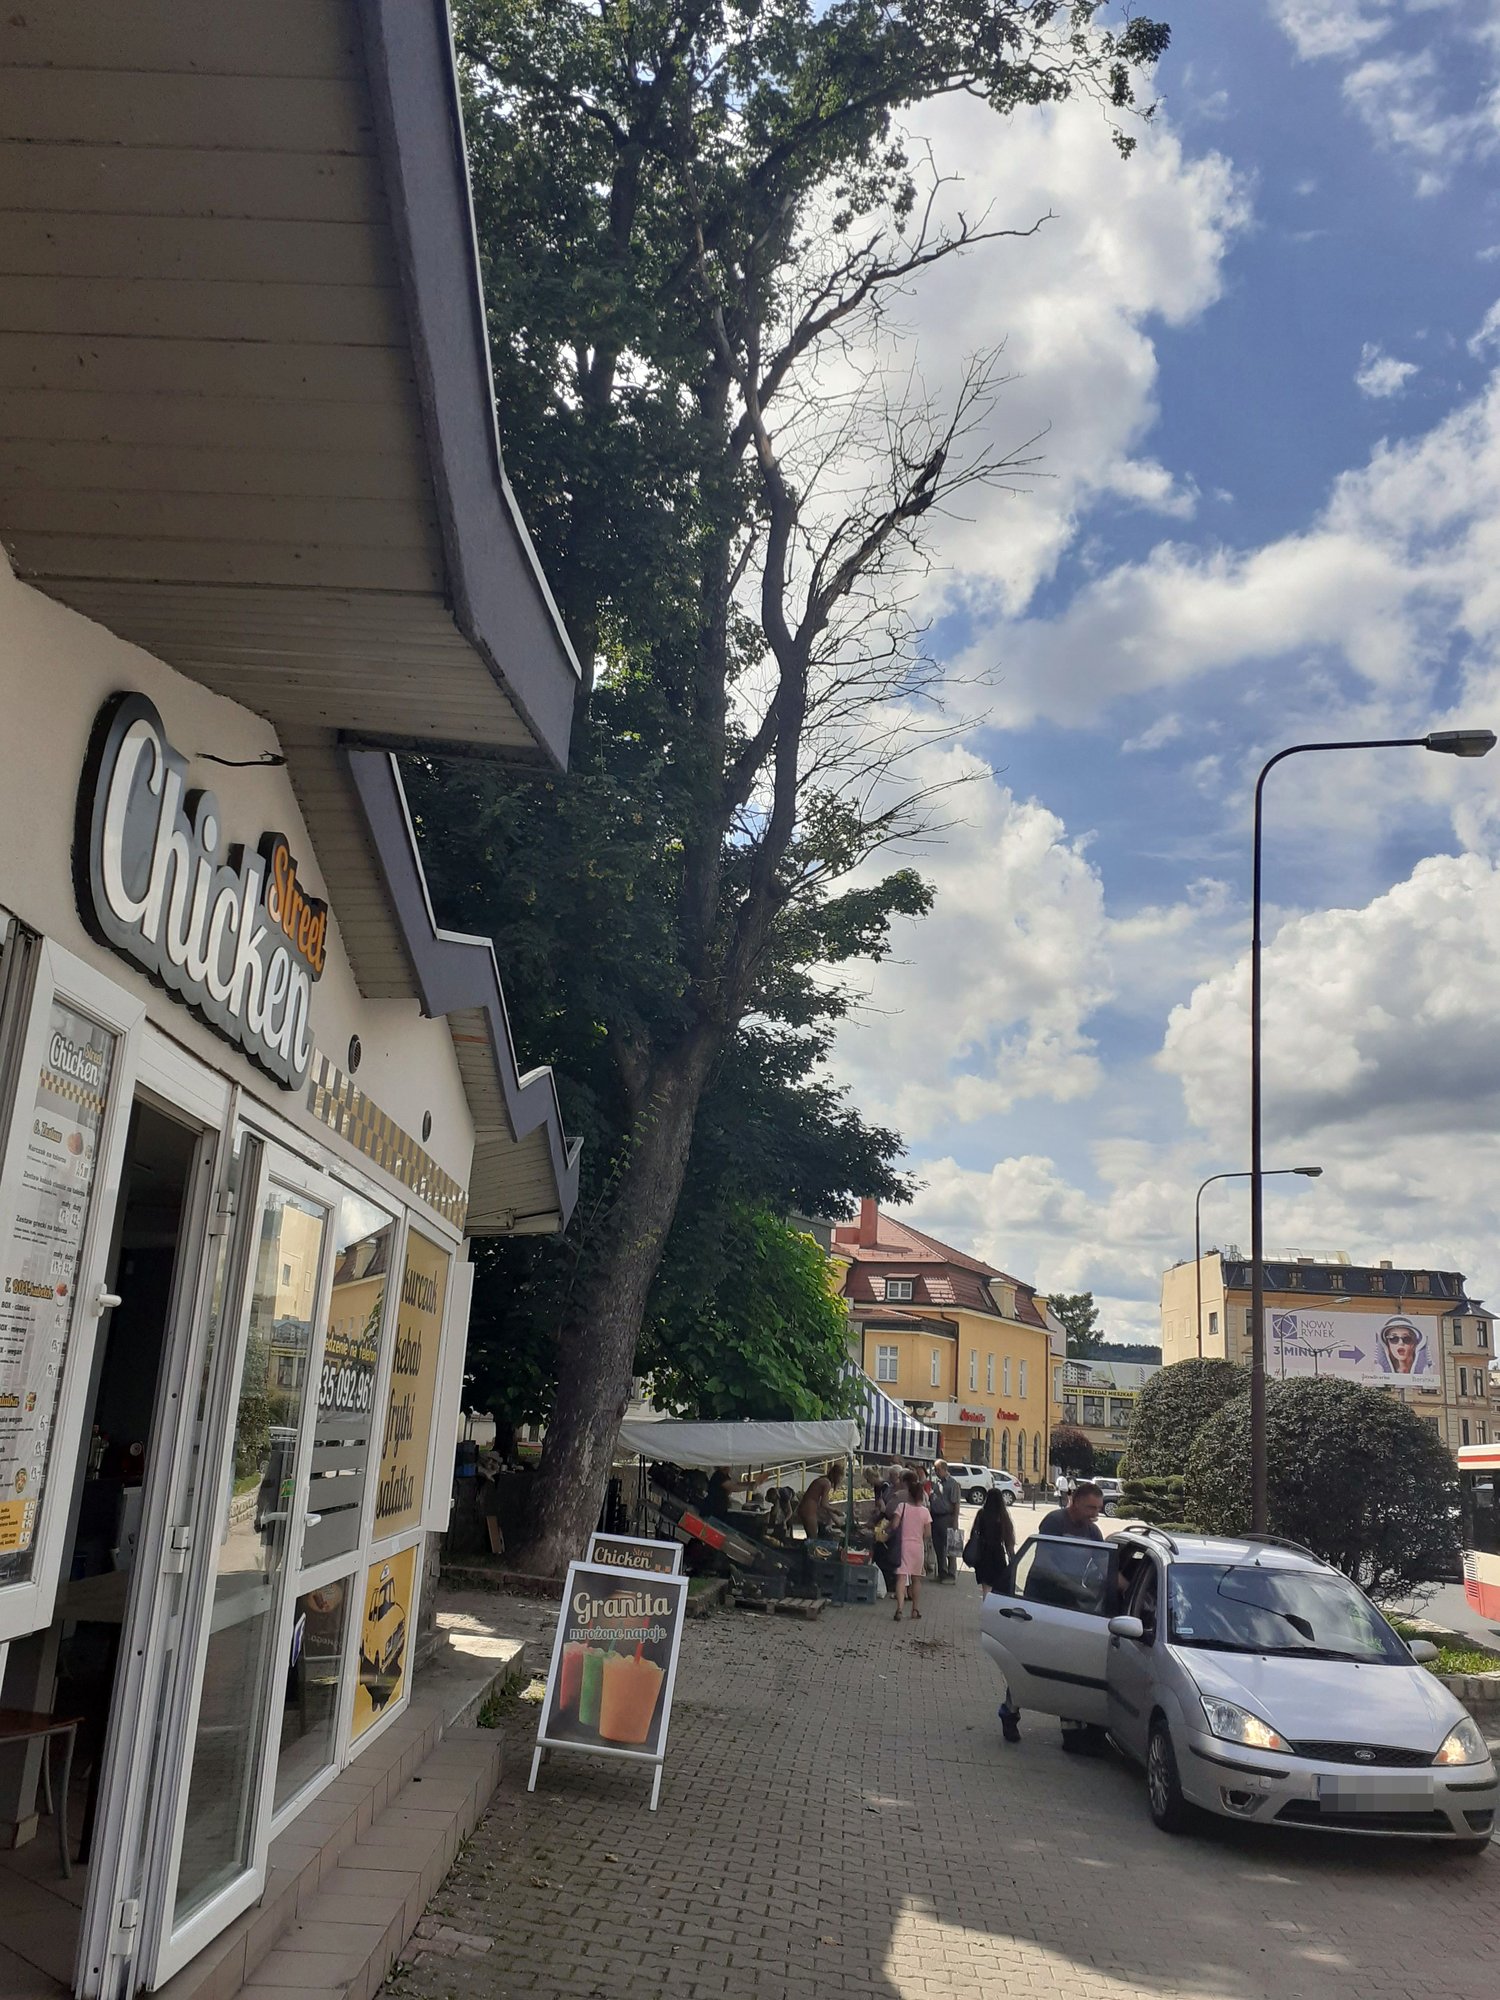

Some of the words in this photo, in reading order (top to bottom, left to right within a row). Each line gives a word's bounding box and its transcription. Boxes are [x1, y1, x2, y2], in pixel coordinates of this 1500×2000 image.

[103, 718, 311, 1074] Chicken
[268, 844, 326, 974] Street
[50, 1034, 99, 1087] Chicken
[85, 1043, 103, 1066] Street
[401, 1253, 439, 1316] kurczak
[1300, 1320, 1335, 1329] NOWY
[1301, 1329, 1336, 1338] RYNEK
[350, 1343, 358, 1358] na
[359, 1340, 378, 1362] telefon
[392, 1322, 423, 1377] kebab
[1273, 1345, 1281, 1355] 3
[1284, 1346, 1333, 1358] MINUTY
[319, 1364, 336, 1407] 35
[336, 1367, 357, 1408] 092
[356, 1371, 375, 1410] 961
[382, 1387, 416, 1460] frytki
[376, 1464, 415, 1520] sałatka
[593, 1546, 651, 1569] Chicken
[632, 1547, 654, 1558] Street
[573, 1591, 673, 1625] Granita
[569, 1625, 624, 1641] mrożone
[624, 1624, 668, 1644] napoje
